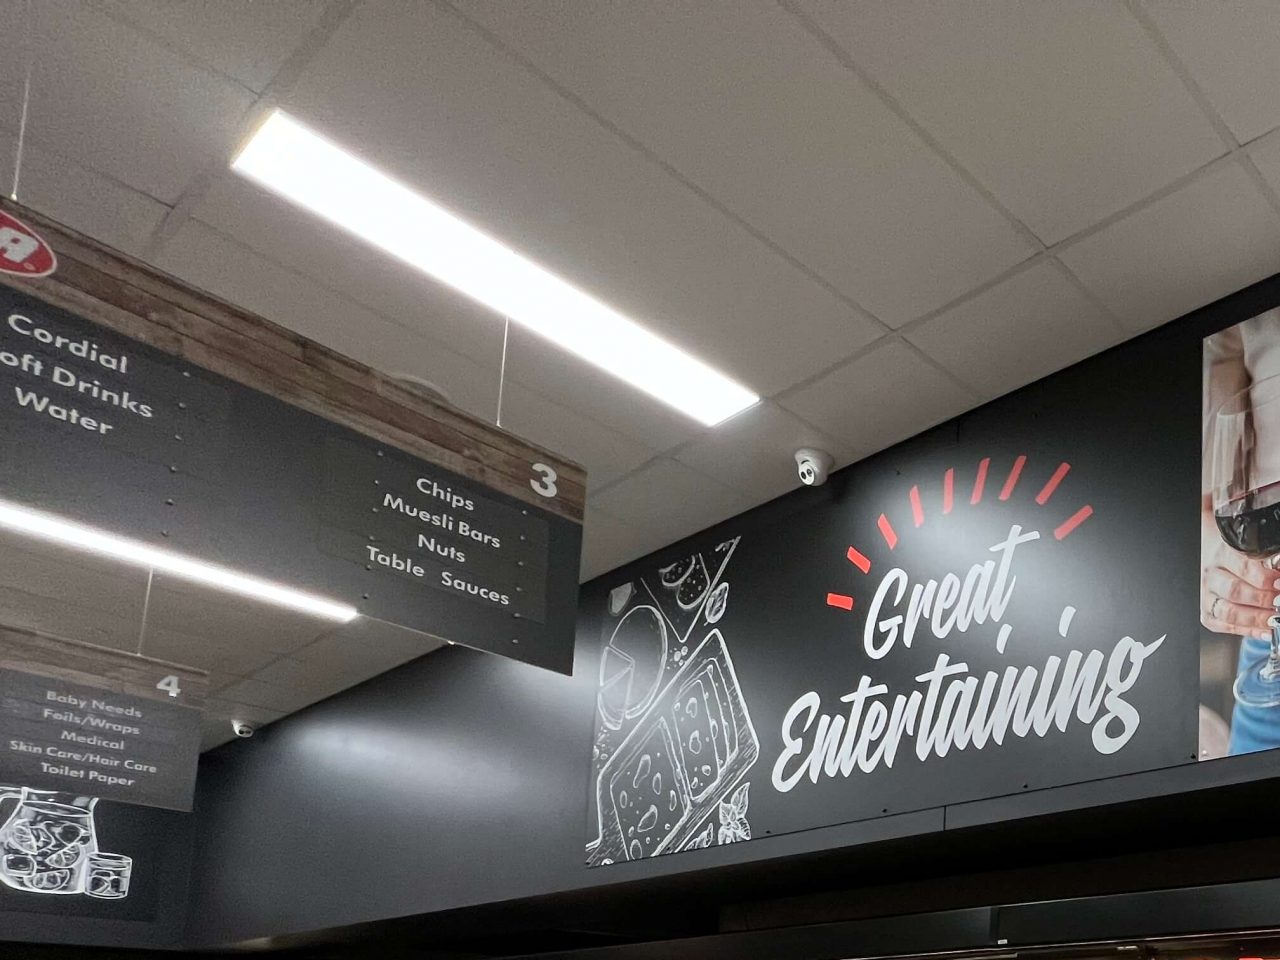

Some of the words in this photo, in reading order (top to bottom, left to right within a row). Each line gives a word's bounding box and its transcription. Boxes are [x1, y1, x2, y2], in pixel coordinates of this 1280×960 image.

[8, 313, 128, 374] Cordial
[0, 351, 44, 377] oft
[52, 364, 153, 418] Drinks
[15, 387, 114, 436] Water
[416, 477, 475, 512] Chips
[530, 463, 557, 497] 3
[383, 493, 453, 531] Muesli
[458, 521, 501, 548] Bars
[417, 534, 466, 563] Nuts
[366, 546, 425, 579] Table
[441, 570, 510, 606] Sauces
[863, 524, 1040, 660] Great
[156, 675, 181, 698] 4
[771, 605, 1168, 793] Entertaining
[43, 708, 141, 735] Foils/Wraps
[46, 690, 88, 709] Baby
[92, 699, 142, 719] Needs
[9, 740, 43, 755] Skin
[46, 746, 120, 767] Care/Hair
[124, 759, 157, 774] Care
[61, 730, 125, 750] Medical
[40, 762, 85, 779] Toilet
[89, 771, 136, 787] Paper
